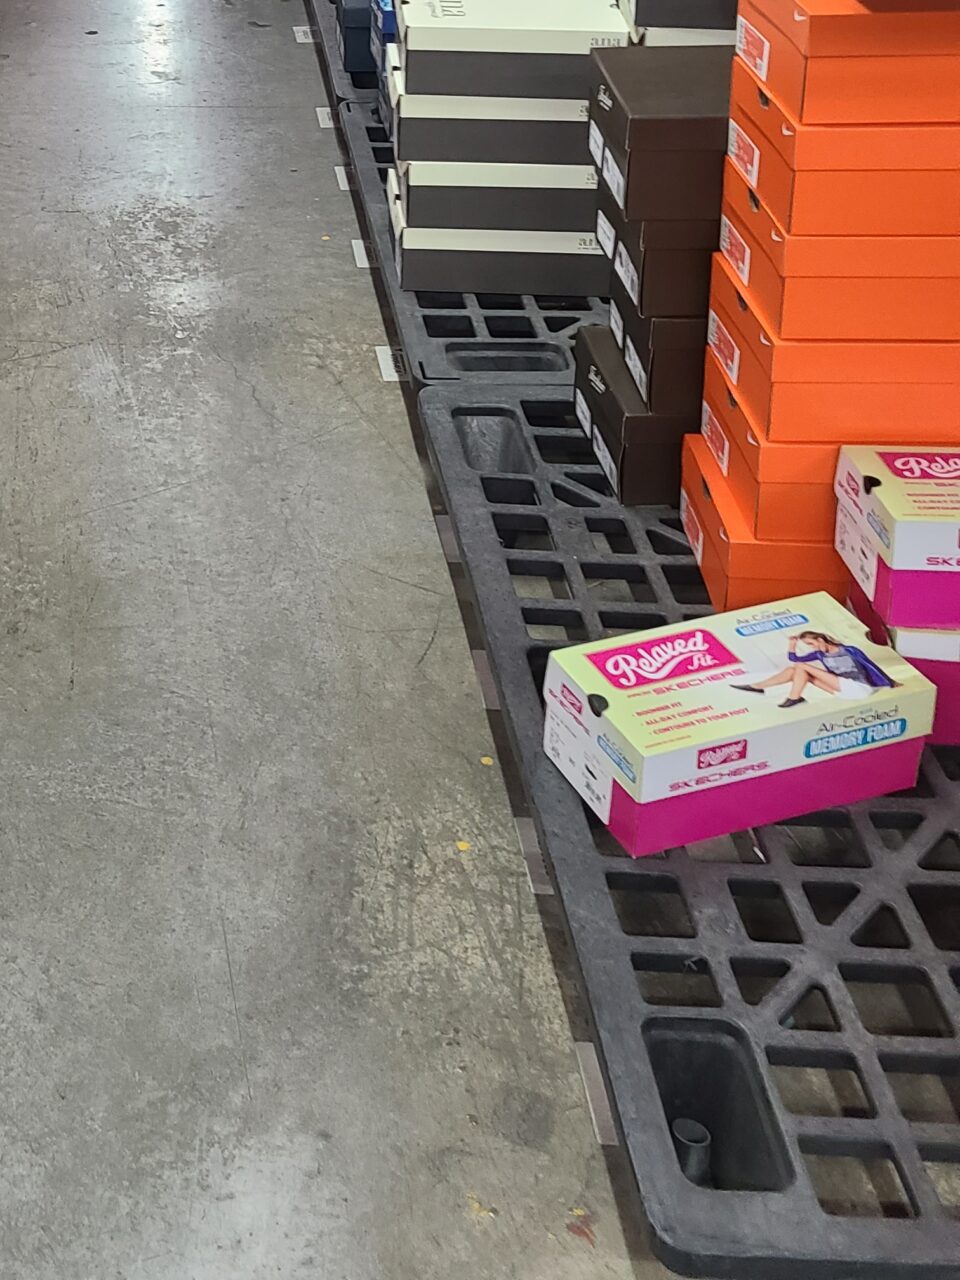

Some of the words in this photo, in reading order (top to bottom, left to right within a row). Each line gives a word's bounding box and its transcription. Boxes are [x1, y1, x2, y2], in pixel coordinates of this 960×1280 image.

[590, 36, 622, 46] ana
[894, 456, 960, 478] Rela
[742, 620, 779, 636] MEMORY
[779, 615, 805, 628] FOAM
[605, 631, 710, 687] Relaxed
[652, 668, 748, 696] SKECHERS
[729, 707, 750, 719] FOOT
[816, 704, 900, 736] Air-Cooled
[809, 732, 865, 758] MEMORY
[865, 719, 904, 743] FOAM
[668, 760, 771, 793] SKECHERS
